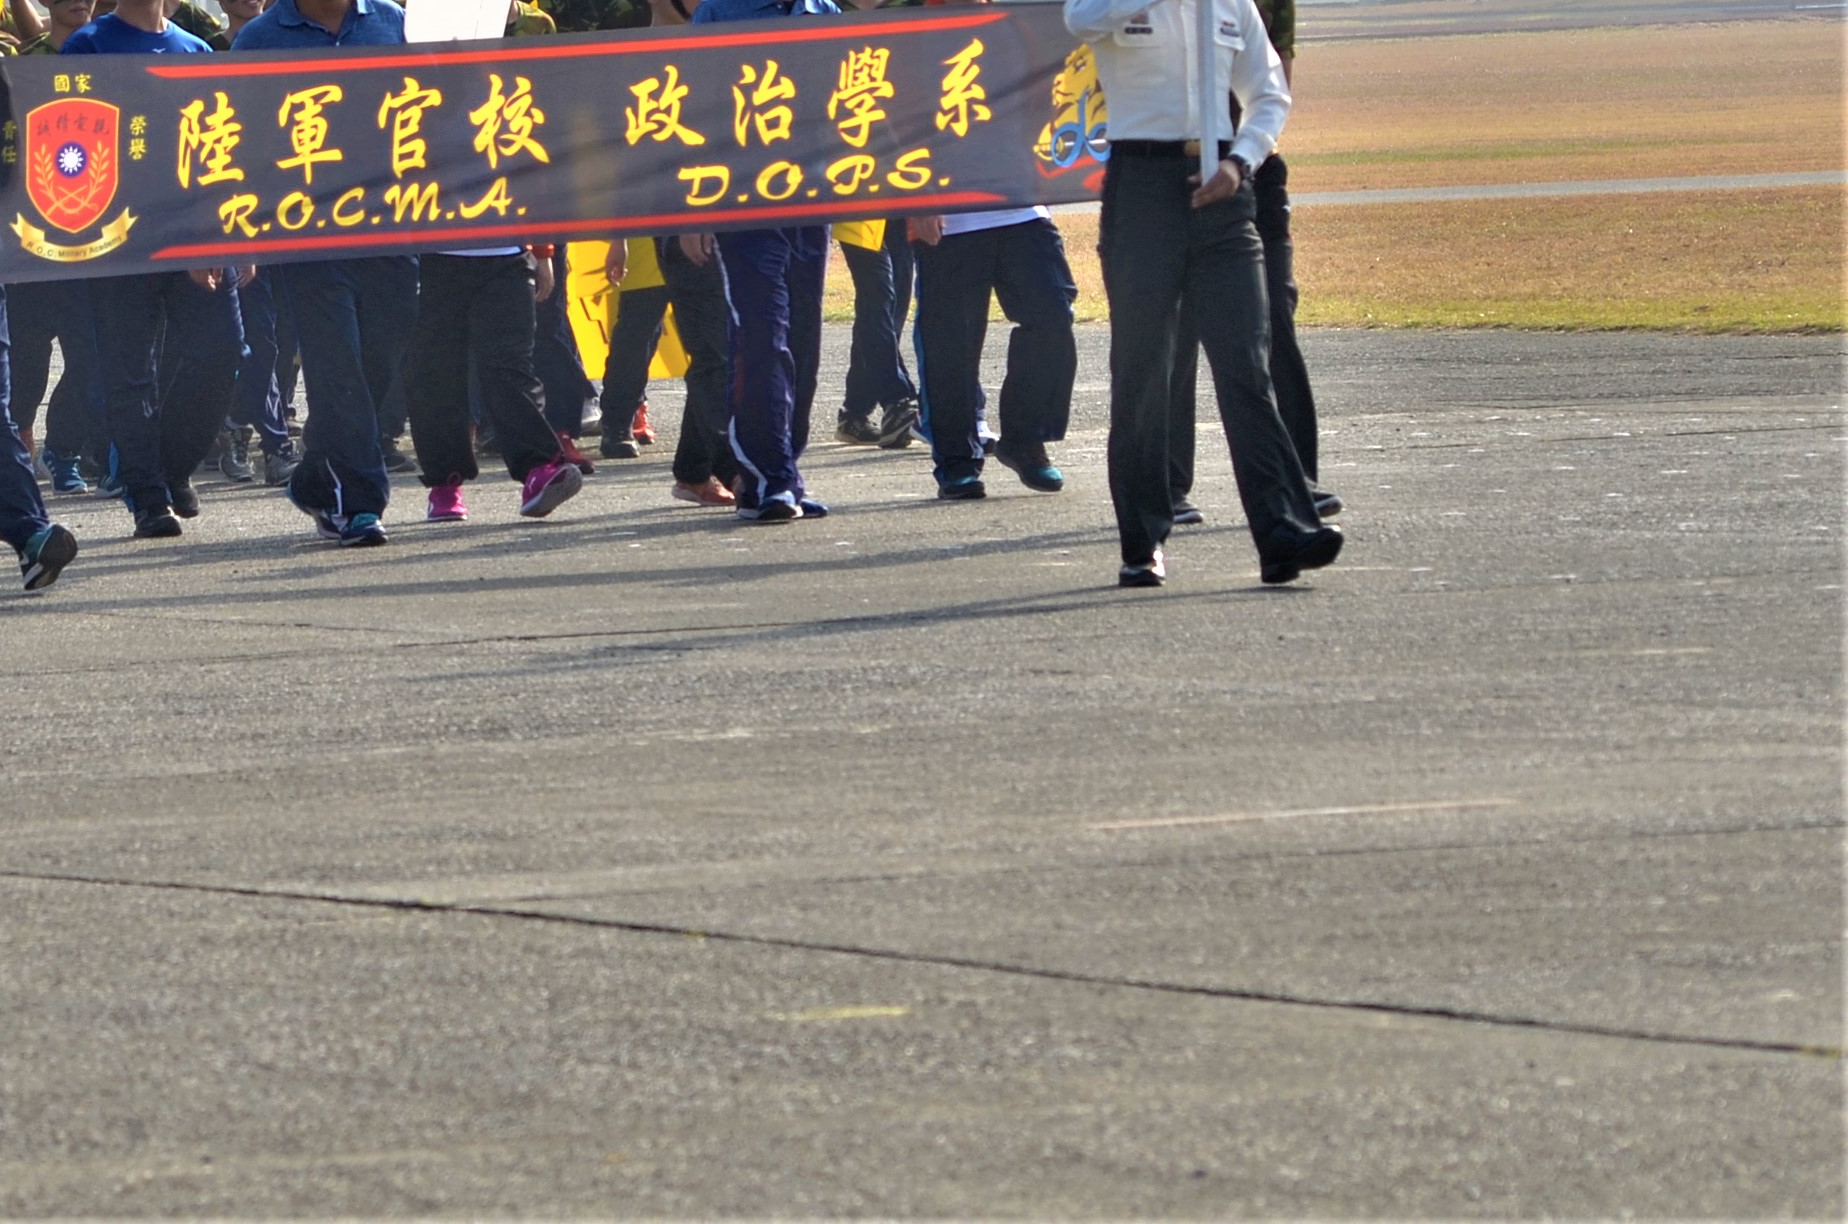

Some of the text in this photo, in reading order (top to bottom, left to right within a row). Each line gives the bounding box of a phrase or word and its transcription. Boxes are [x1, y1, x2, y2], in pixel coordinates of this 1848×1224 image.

[54, 74, 92, 93] 國家
[129, 114, 147, 161] 榮譽
[177, 74, 551, 189] 陸軍官校
[625, 38, 993, 148] 政治學系
[678, 148, 952, 207] D.O.P.S.
[219, 176, 528, 239] R.O.C.M.A.
